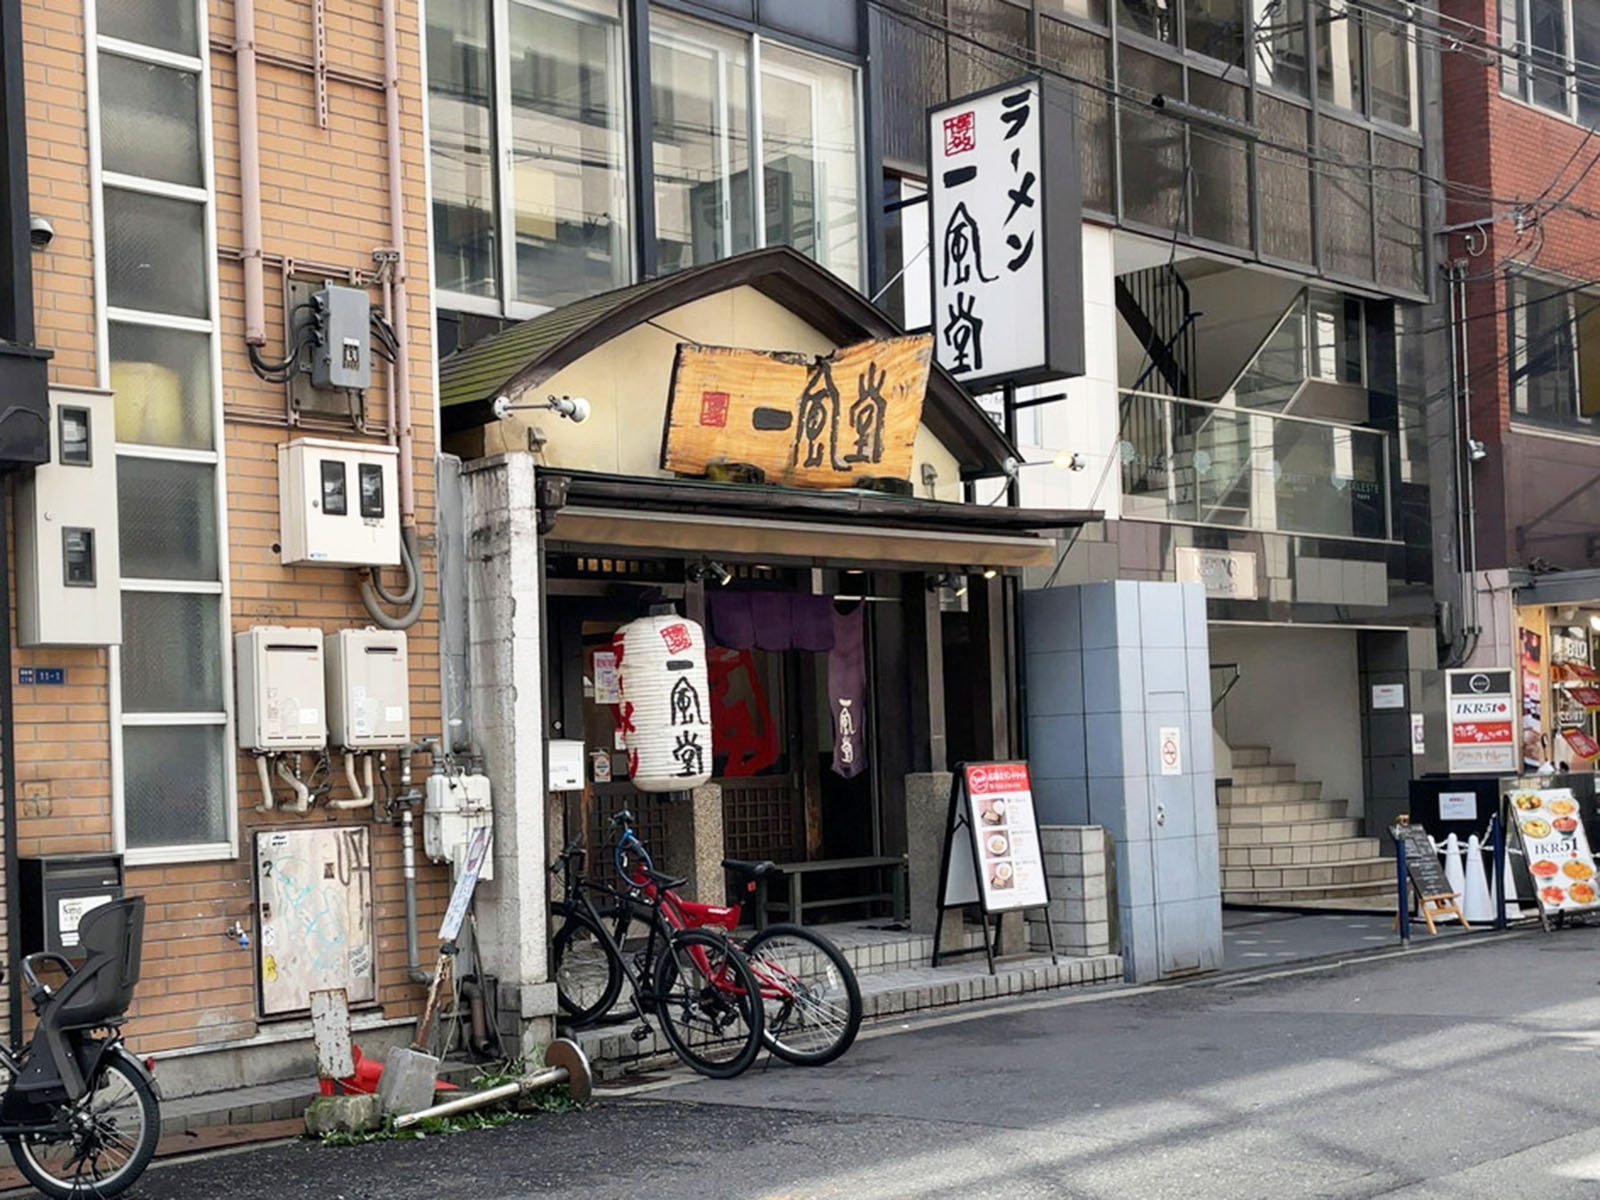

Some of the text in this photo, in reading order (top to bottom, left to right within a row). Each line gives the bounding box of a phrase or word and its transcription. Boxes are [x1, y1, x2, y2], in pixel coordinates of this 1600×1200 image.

[1000, 89, 1036, 272] ラーメン
[943, 165, 999, 375] 一風堂
[752, 360, 888, 472] 一風堂
[666, 659, 708, 778] 一風堂
[839, 698, 857, 763] 一風堂
[1456, 703, 1498, 715] IKR51
[1535, 837, 1578, 855] IKR51
